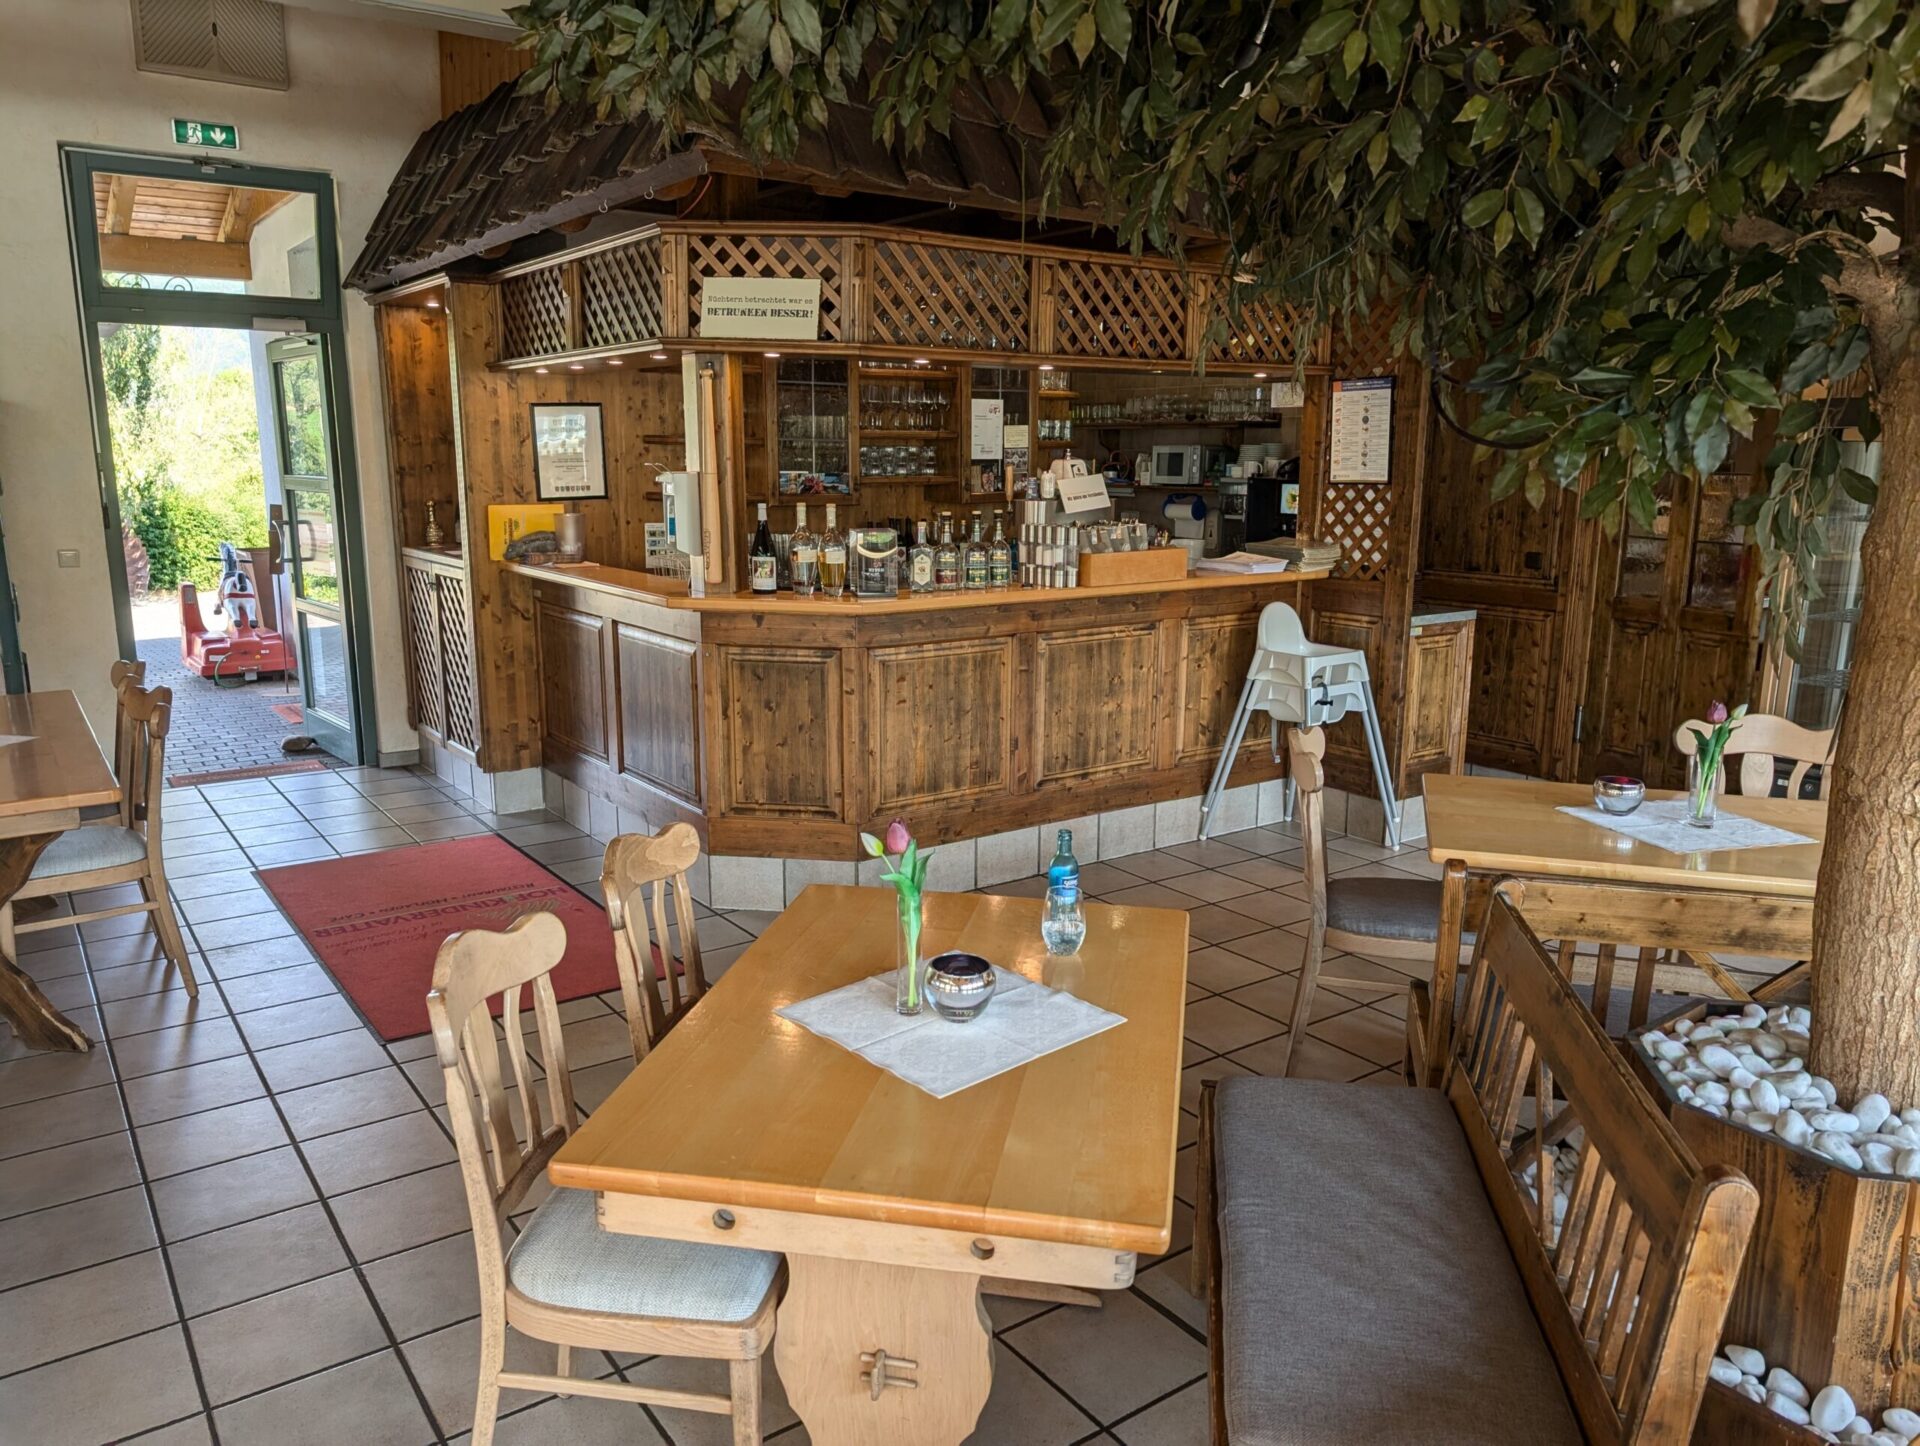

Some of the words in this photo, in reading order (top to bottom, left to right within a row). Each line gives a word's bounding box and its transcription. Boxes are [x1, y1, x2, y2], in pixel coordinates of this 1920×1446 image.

[708, 295, 743, 303] Nüchtern
[744, 296, 787, 304] betrachtet
[707, 307, 767, 317] BETRUNKEN
[770, 308, 813, 319] BESSER!
